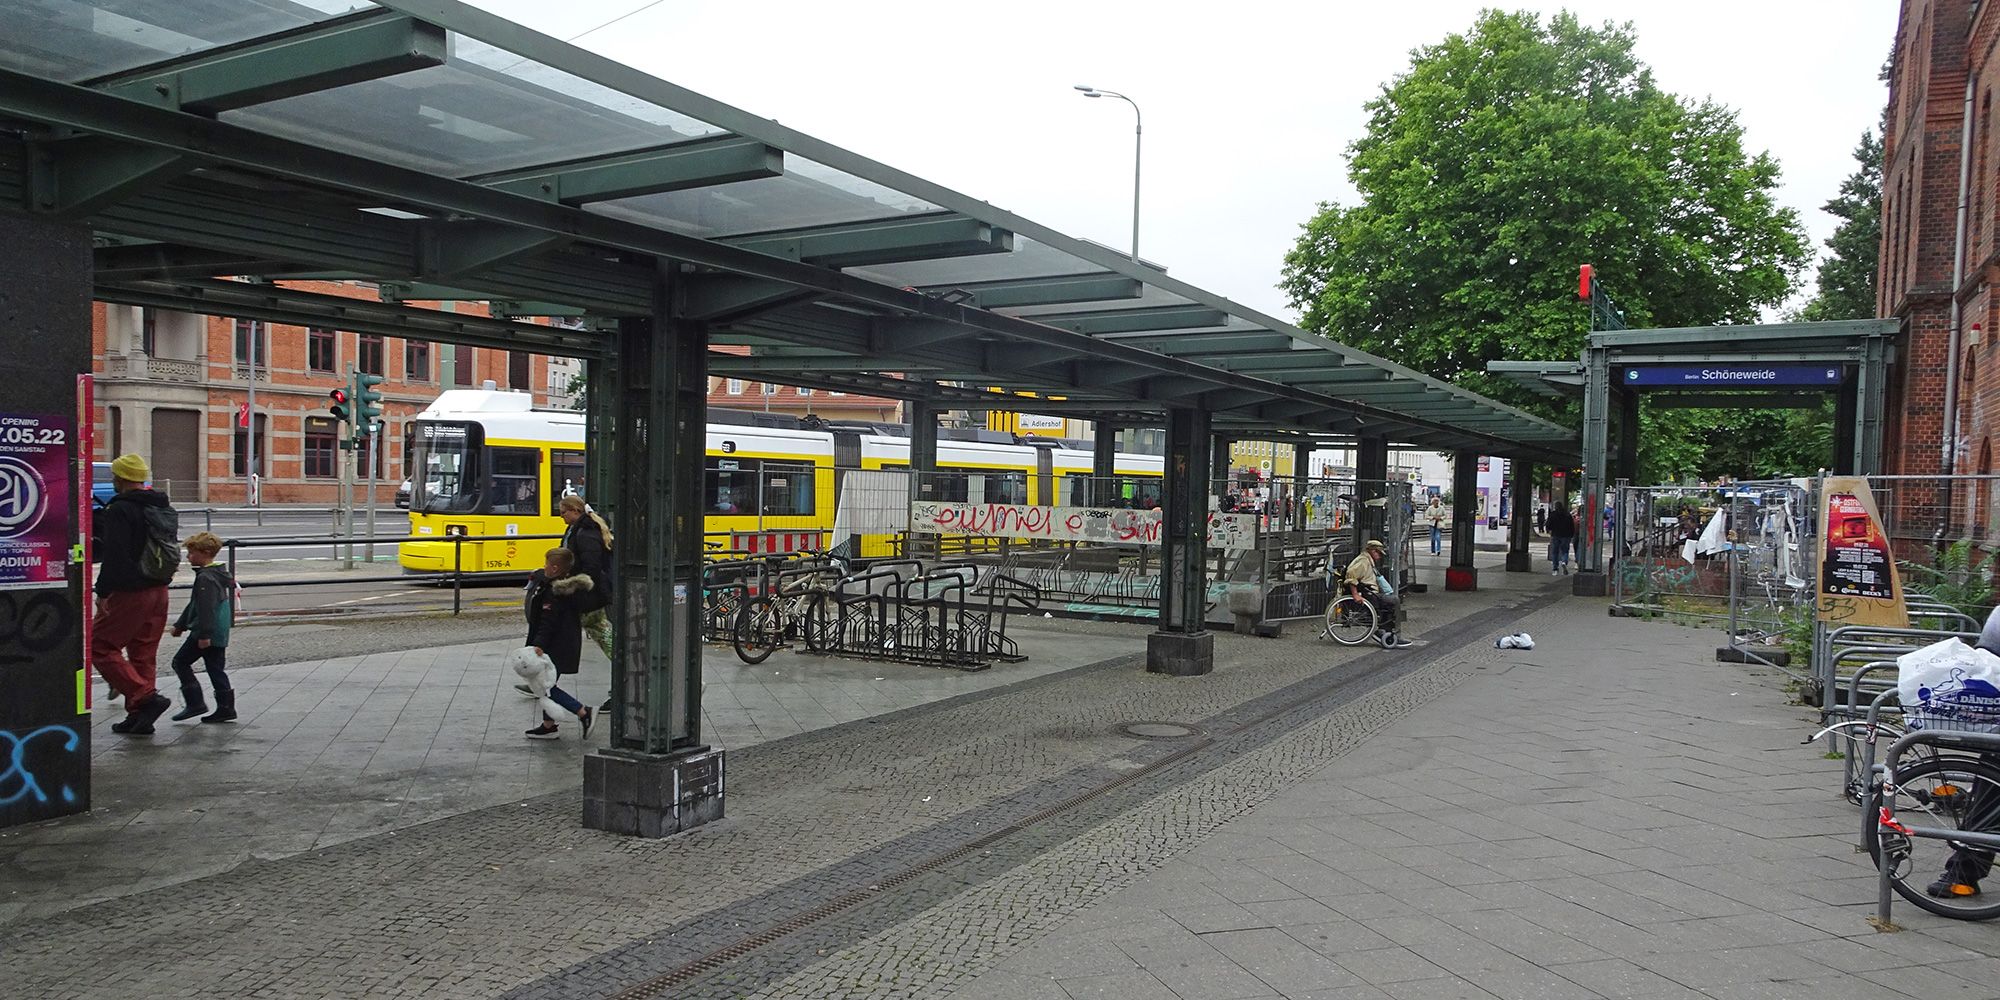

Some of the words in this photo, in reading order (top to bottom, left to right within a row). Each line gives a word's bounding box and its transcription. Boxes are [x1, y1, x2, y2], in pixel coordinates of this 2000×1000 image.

[1702, 369, 1776, 380] Schöneweide
[1, 417, 39, 427] OPENING
[486, 560, 511, 568] 1576-A
